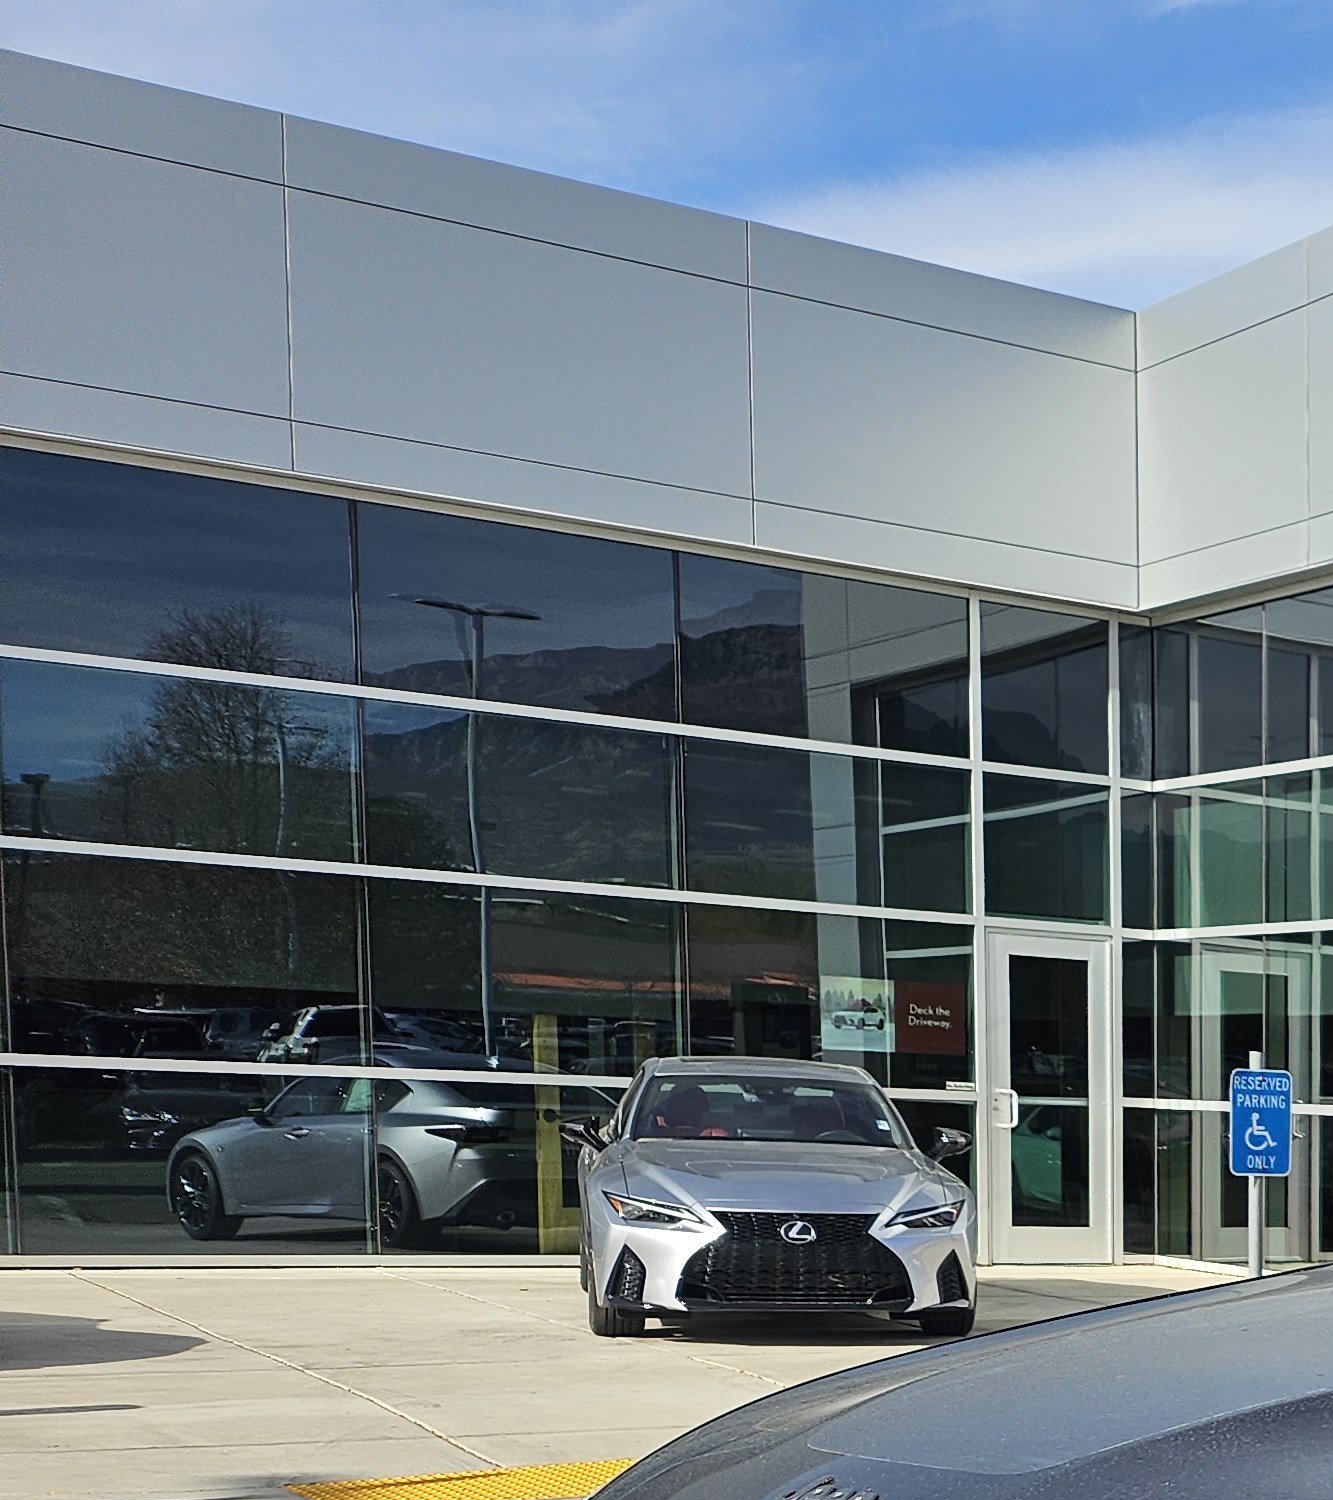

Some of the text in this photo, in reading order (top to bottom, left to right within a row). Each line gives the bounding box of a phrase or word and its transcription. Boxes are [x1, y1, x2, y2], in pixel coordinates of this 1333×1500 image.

[909, 1003, 951, 1017] Deck the
[1233, 1075, 1290, 1092] RESERVED
[1236, 1094, 1287, 1110] PARKING
[1246, 1154, 1277, 1170] ONLY
